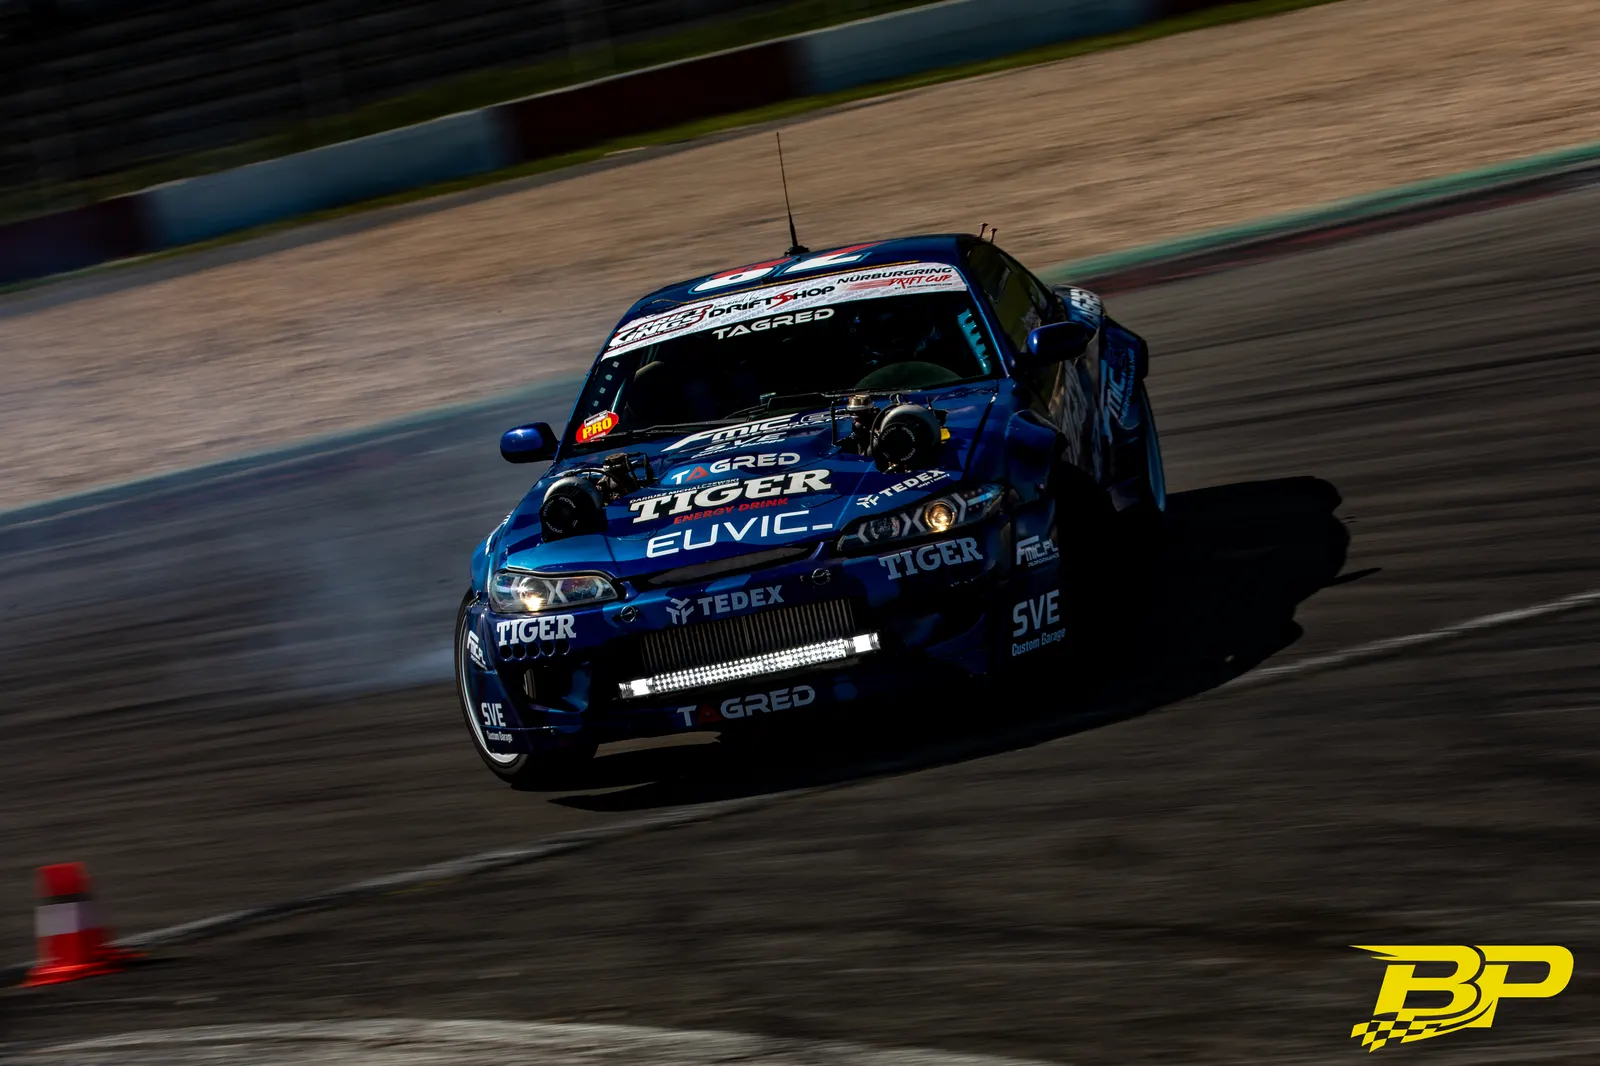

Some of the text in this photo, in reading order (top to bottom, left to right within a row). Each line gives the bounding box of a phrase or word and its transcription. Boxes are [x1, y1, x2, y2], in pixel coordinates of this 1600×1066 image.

[711, 307, 835, 341] TAGRED
[582, 417, 613, 440] PRO
[671, 452, 801, 486] TAGRED
[878, 469, 946, 497] TEDEX
[629, 468, 832, 524] TIGER
[673, 497, 789, 525] ENERGY DRINK
[878, 536, 984, 581] TIGER
[697, 585, 785, 616] TEDEX
[1012, 588, 1060, 638] SVE
[496, 614, 577, 648] TIGER
[1011, 637, 1041, 657] Custom
[481, 702, 507, 728] SVE
[676, 684, 816, 728] TAGRED
